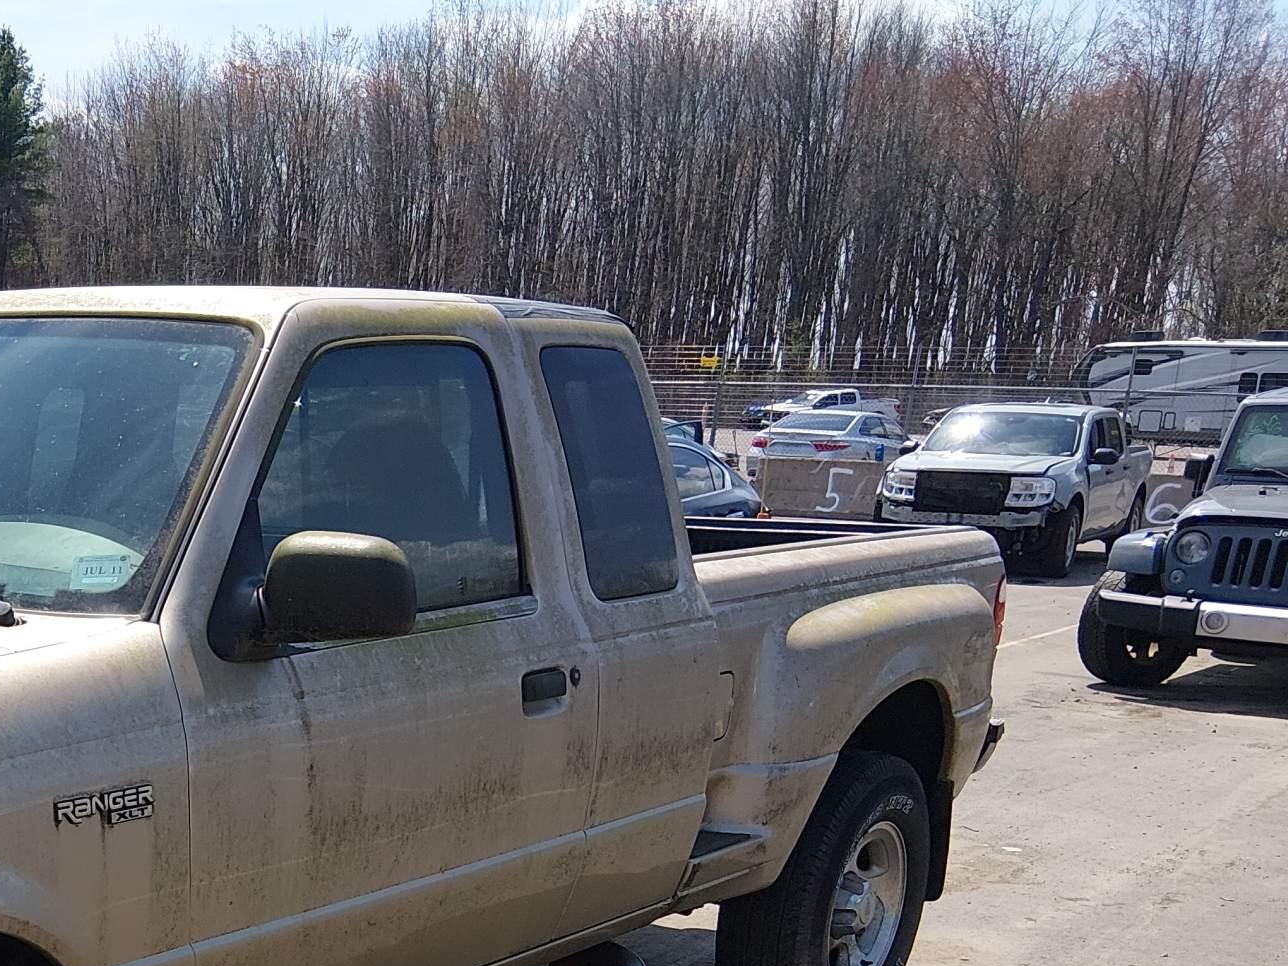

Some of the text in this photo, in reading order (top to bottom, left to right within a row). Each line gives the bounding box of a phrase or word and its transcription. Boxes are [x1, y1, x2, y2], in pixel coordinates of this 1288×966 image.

[815, 467, 854, 513] 5
[1145, 482, 1182, 525] 6
[82, 566, 123, 576] JUL 11
[114, 807, 150, 822] XLT
